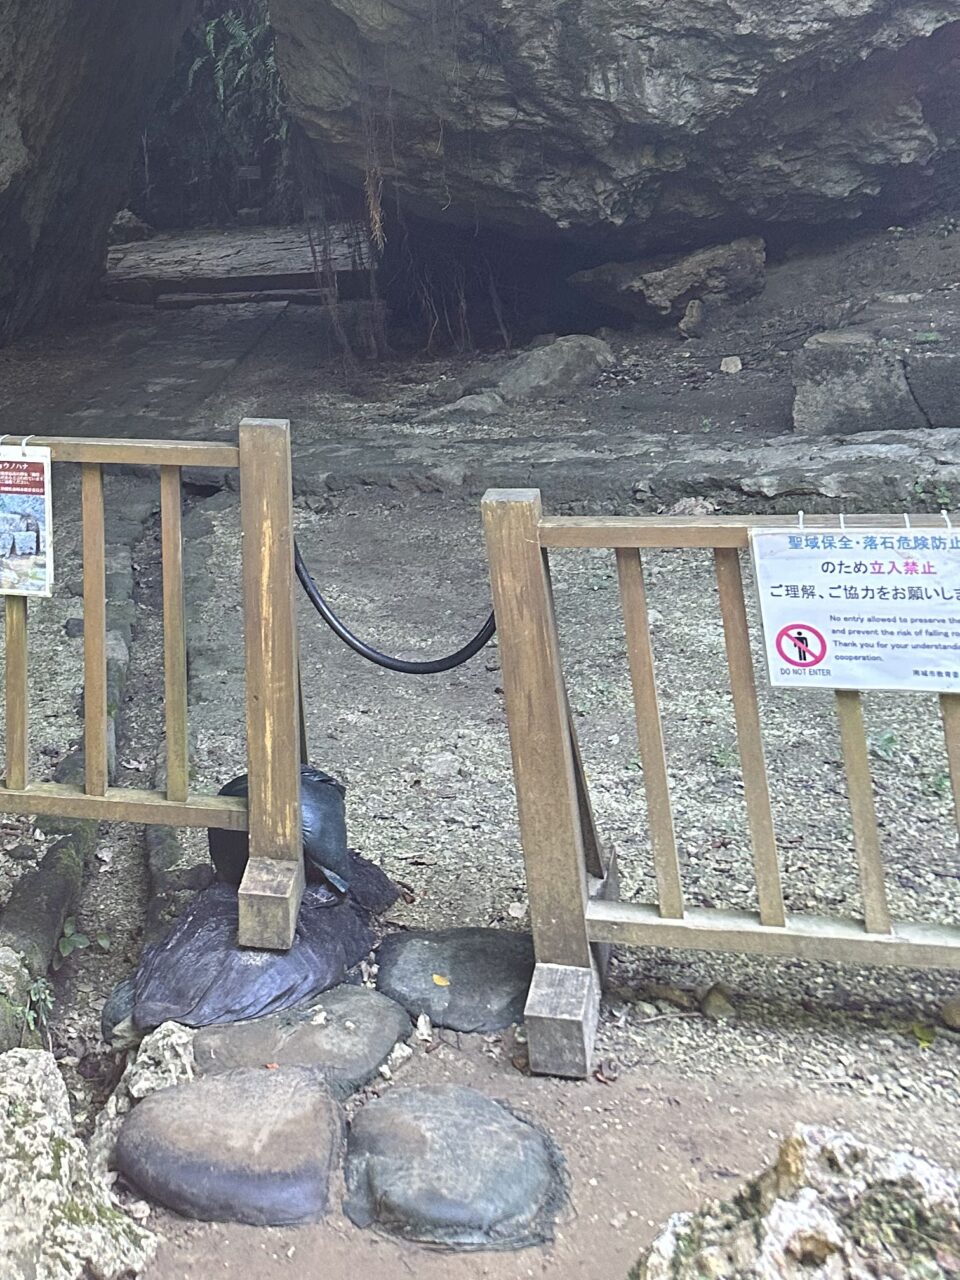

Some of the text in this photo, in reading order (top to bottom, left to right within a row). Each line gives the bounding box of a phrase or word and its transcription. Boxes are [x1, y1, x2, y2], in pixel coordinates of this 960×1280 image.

[821, 560, 937, 575] のため立入禁止
[829, 614, 841, 622] No
[843, 615, 864, 623] entry
[867, 615, 896, 623] allowed
[897, 628, 912, 636] risk
[925, 629, 950, 638] falling
[833, 640, 858, 648] Thank
[792, 668, 806, 676] NOT
[808, 668, 831, 676] ENTER
